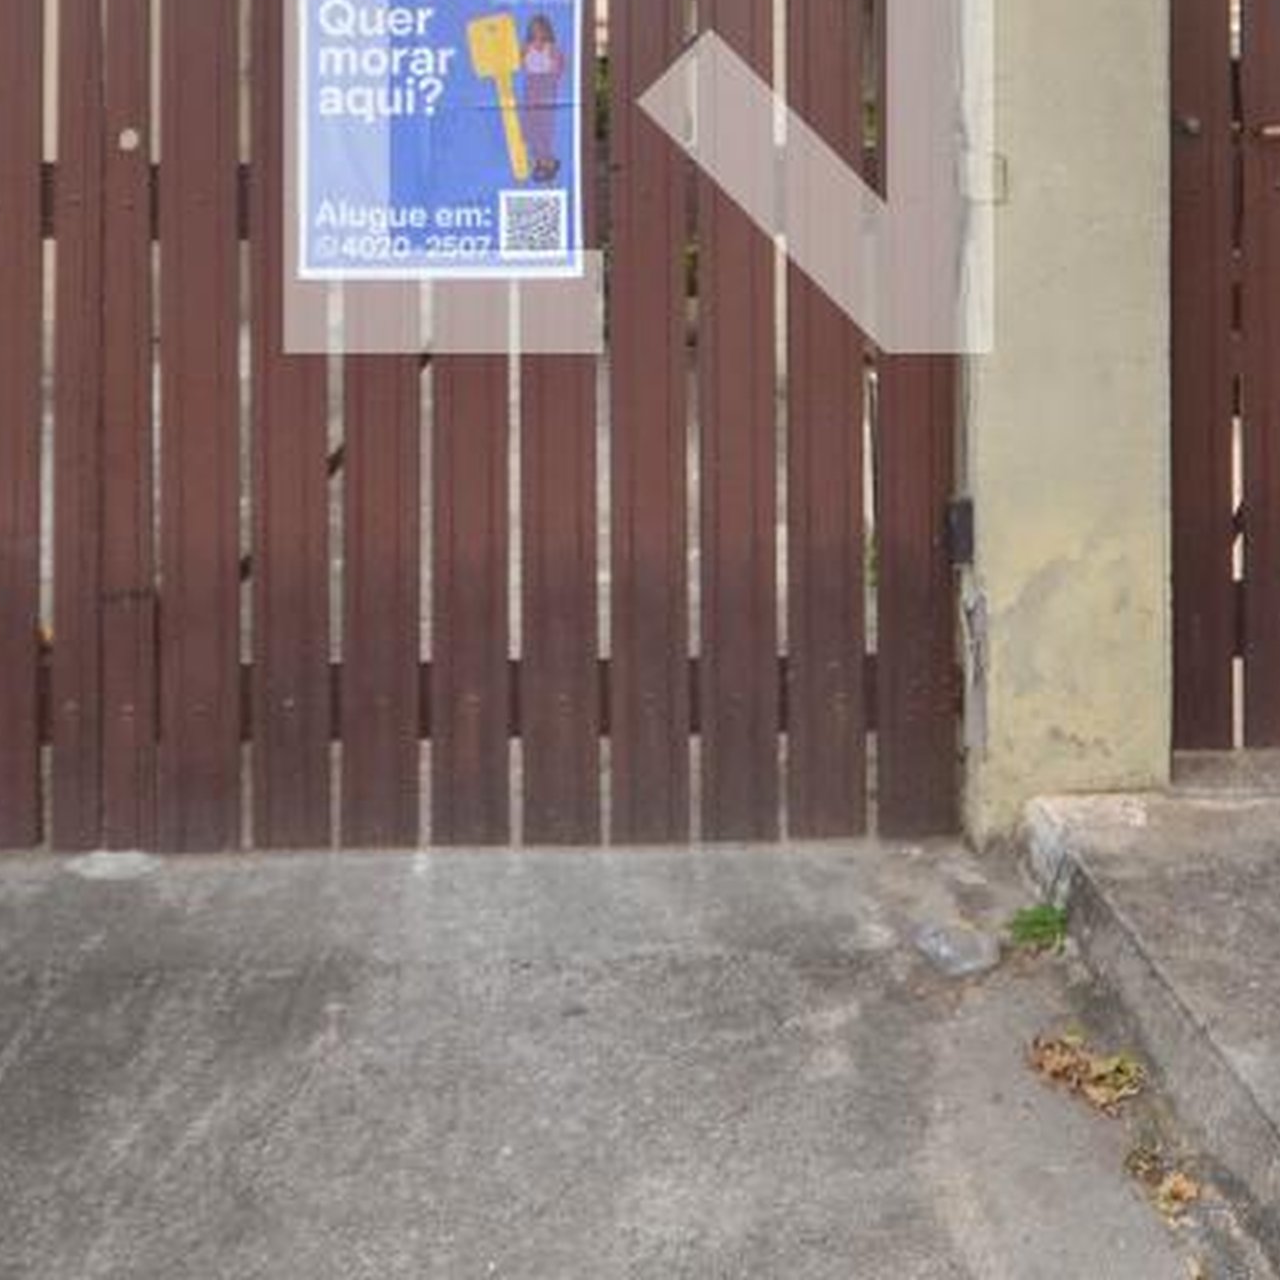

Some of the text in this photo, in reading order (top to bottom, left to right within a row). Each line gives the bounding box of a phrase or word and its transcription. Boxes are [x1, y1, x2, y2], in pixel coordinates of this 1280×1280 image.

[319, 46, 457, 75] morar
[319, 76, 445, 124] aqui?
[315, 199, 493, 234] Alugue em:
